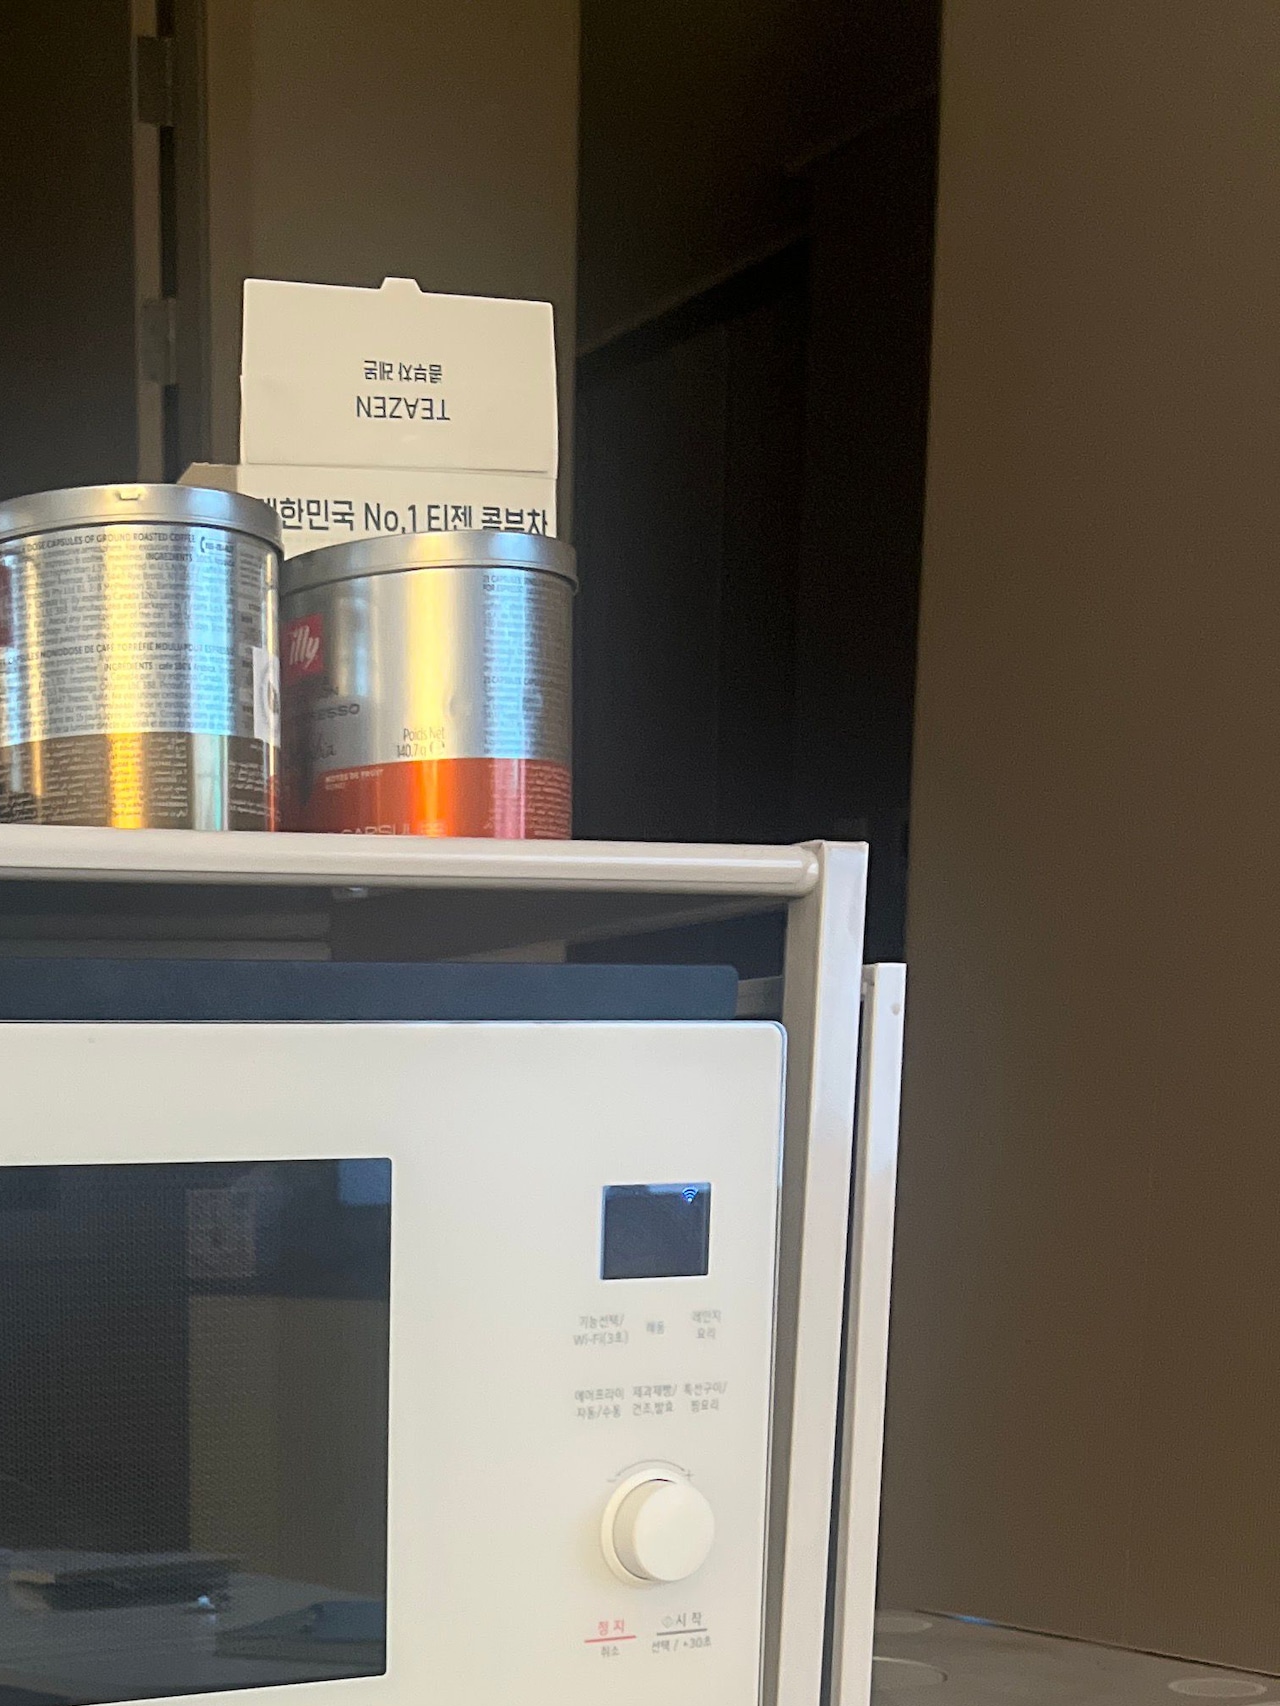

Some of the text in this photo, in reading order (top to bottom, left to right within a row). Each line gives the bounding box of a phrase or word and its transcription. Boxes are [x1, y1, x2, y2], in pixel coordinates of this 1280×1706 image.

[363, 360, 443, 383] 콤부차 레몬
[355, 395, 451, 421] TEAZEN
[427, 504, 473, 531] 티젠
[289, 625, 320, 668] illy
[579, 1313, 625, 1329] 기능선택/
[695, 1326, 717, 1340] 요리
[574, 1386, 625, 1403] 에어프라이
[577, 1404, 621, 1420] 자동/수동
[600, 1644, 620, 1658] 취소
